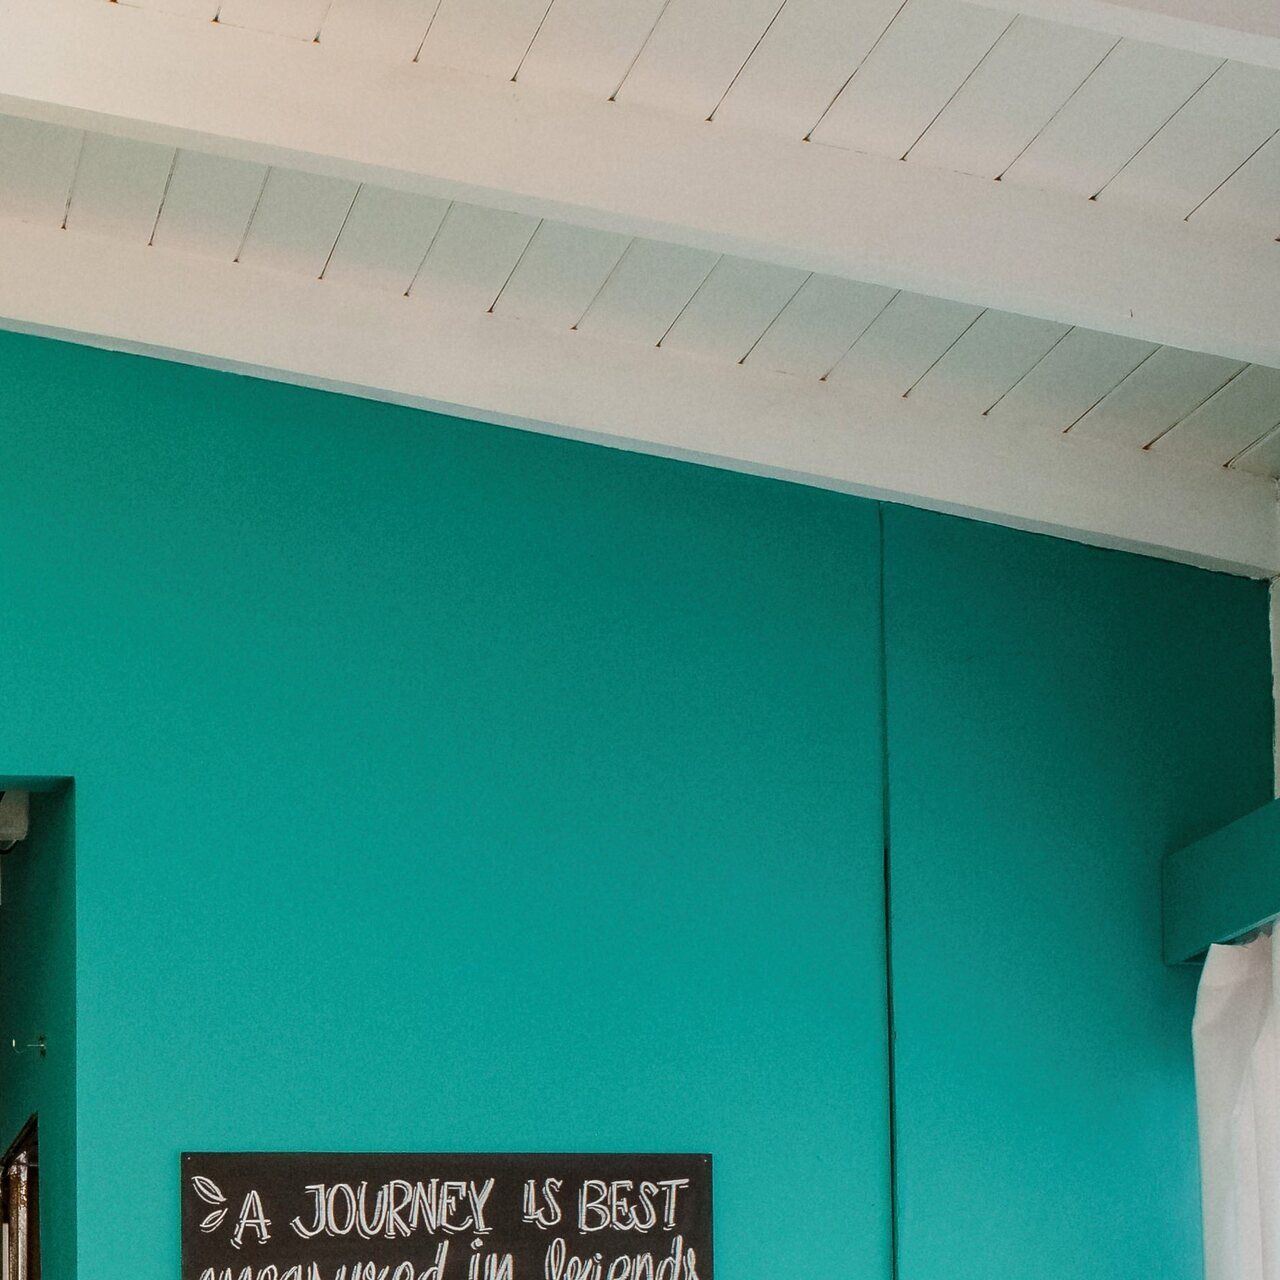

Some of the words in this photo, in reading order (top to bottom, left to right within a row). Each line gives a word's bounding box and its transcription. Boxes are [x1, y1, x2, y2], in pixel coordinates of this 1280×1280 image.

[230, 1190, 271, 1249] A
[290, 1178, 495, 1239] JOURNEY
[523, 1178, 563, 1226] IS
[578, 1178, 690, 1237] BEST
